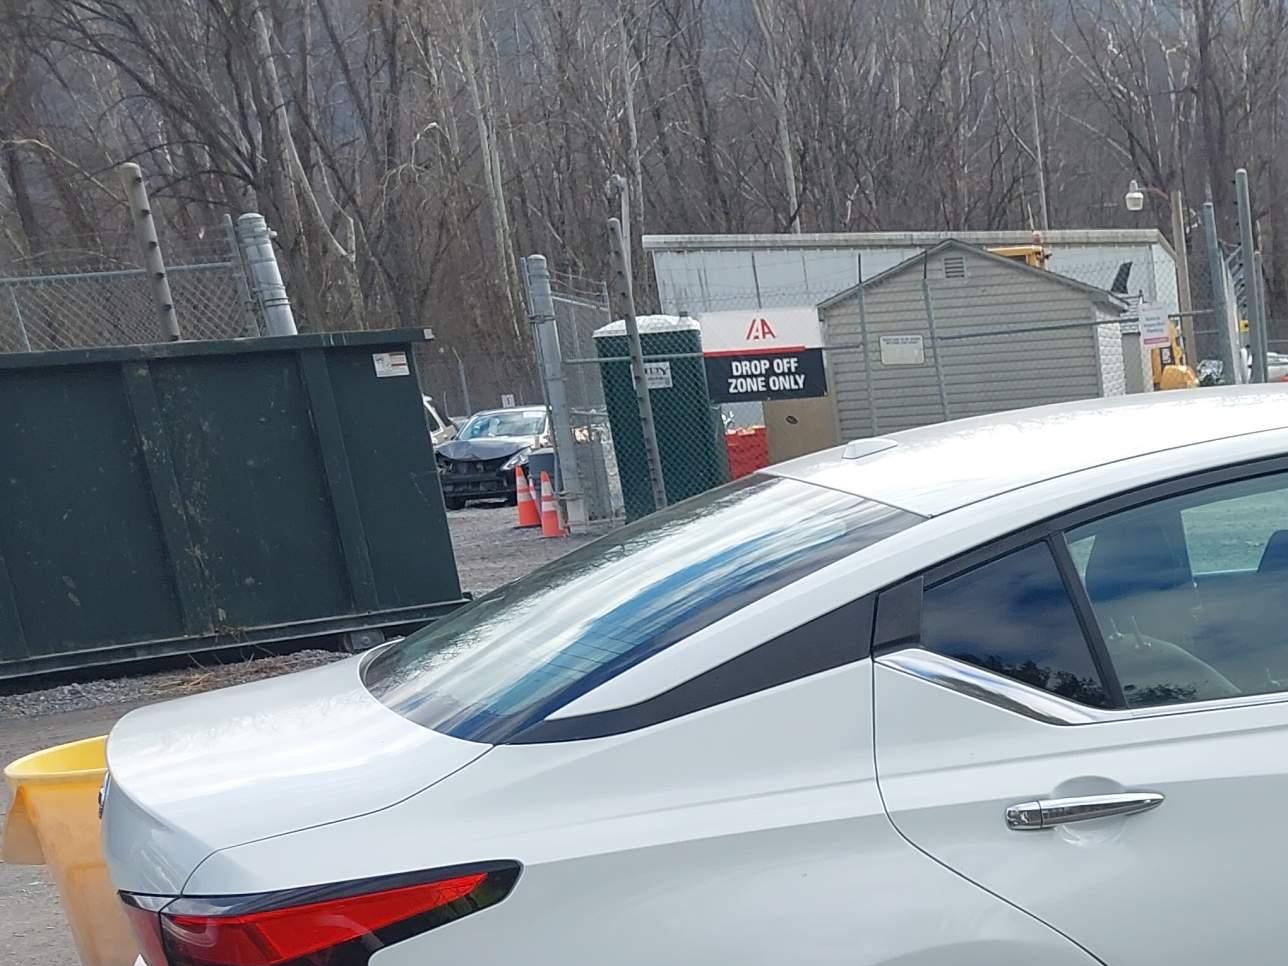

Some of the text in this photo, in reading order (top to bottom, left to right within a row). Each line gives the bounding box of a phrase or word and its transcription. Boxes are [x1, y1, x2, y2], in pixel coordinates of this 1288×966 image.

[731, 358, 798, 376] DROP OFF
[728, 374, 805, 393] ZONE ONLY
